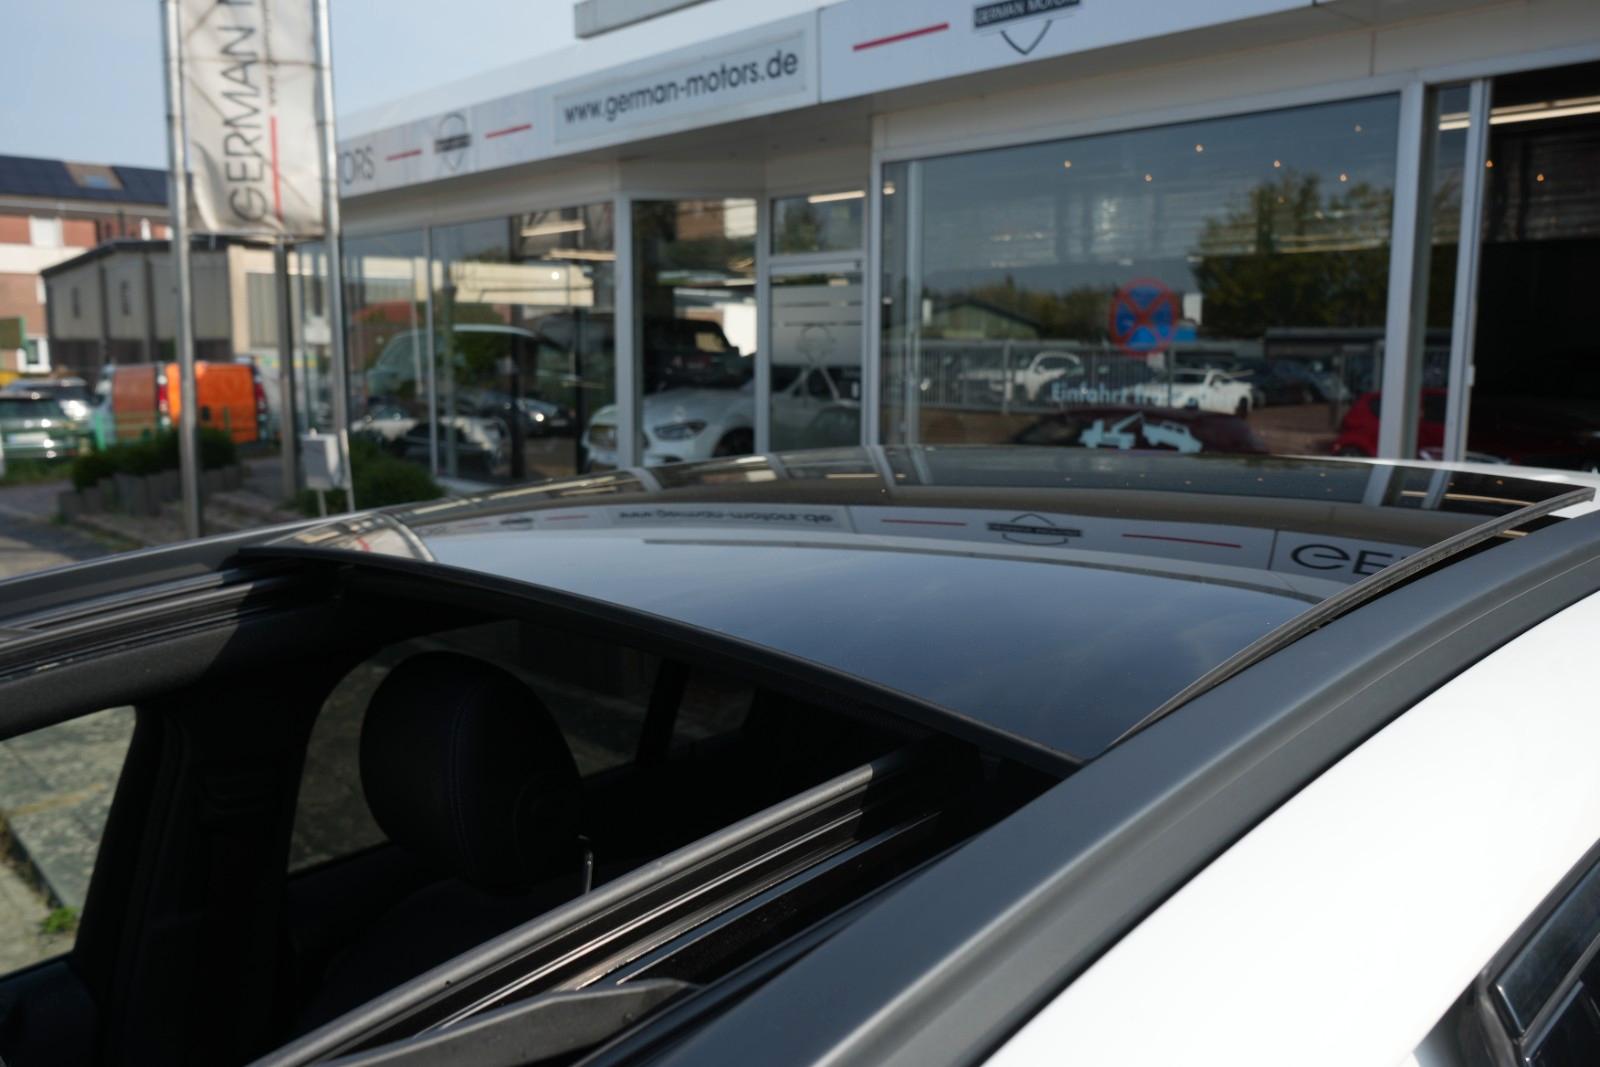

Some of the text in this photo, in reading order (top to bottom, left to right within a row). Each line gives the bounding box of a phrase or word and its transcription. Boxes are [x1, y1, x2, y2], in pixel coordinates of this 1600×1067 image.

[563, 50, 798, 121] www.german-motors.de
[217, 26, 267, 222] GERMAN
[338, 146, 375, 186] ORS
